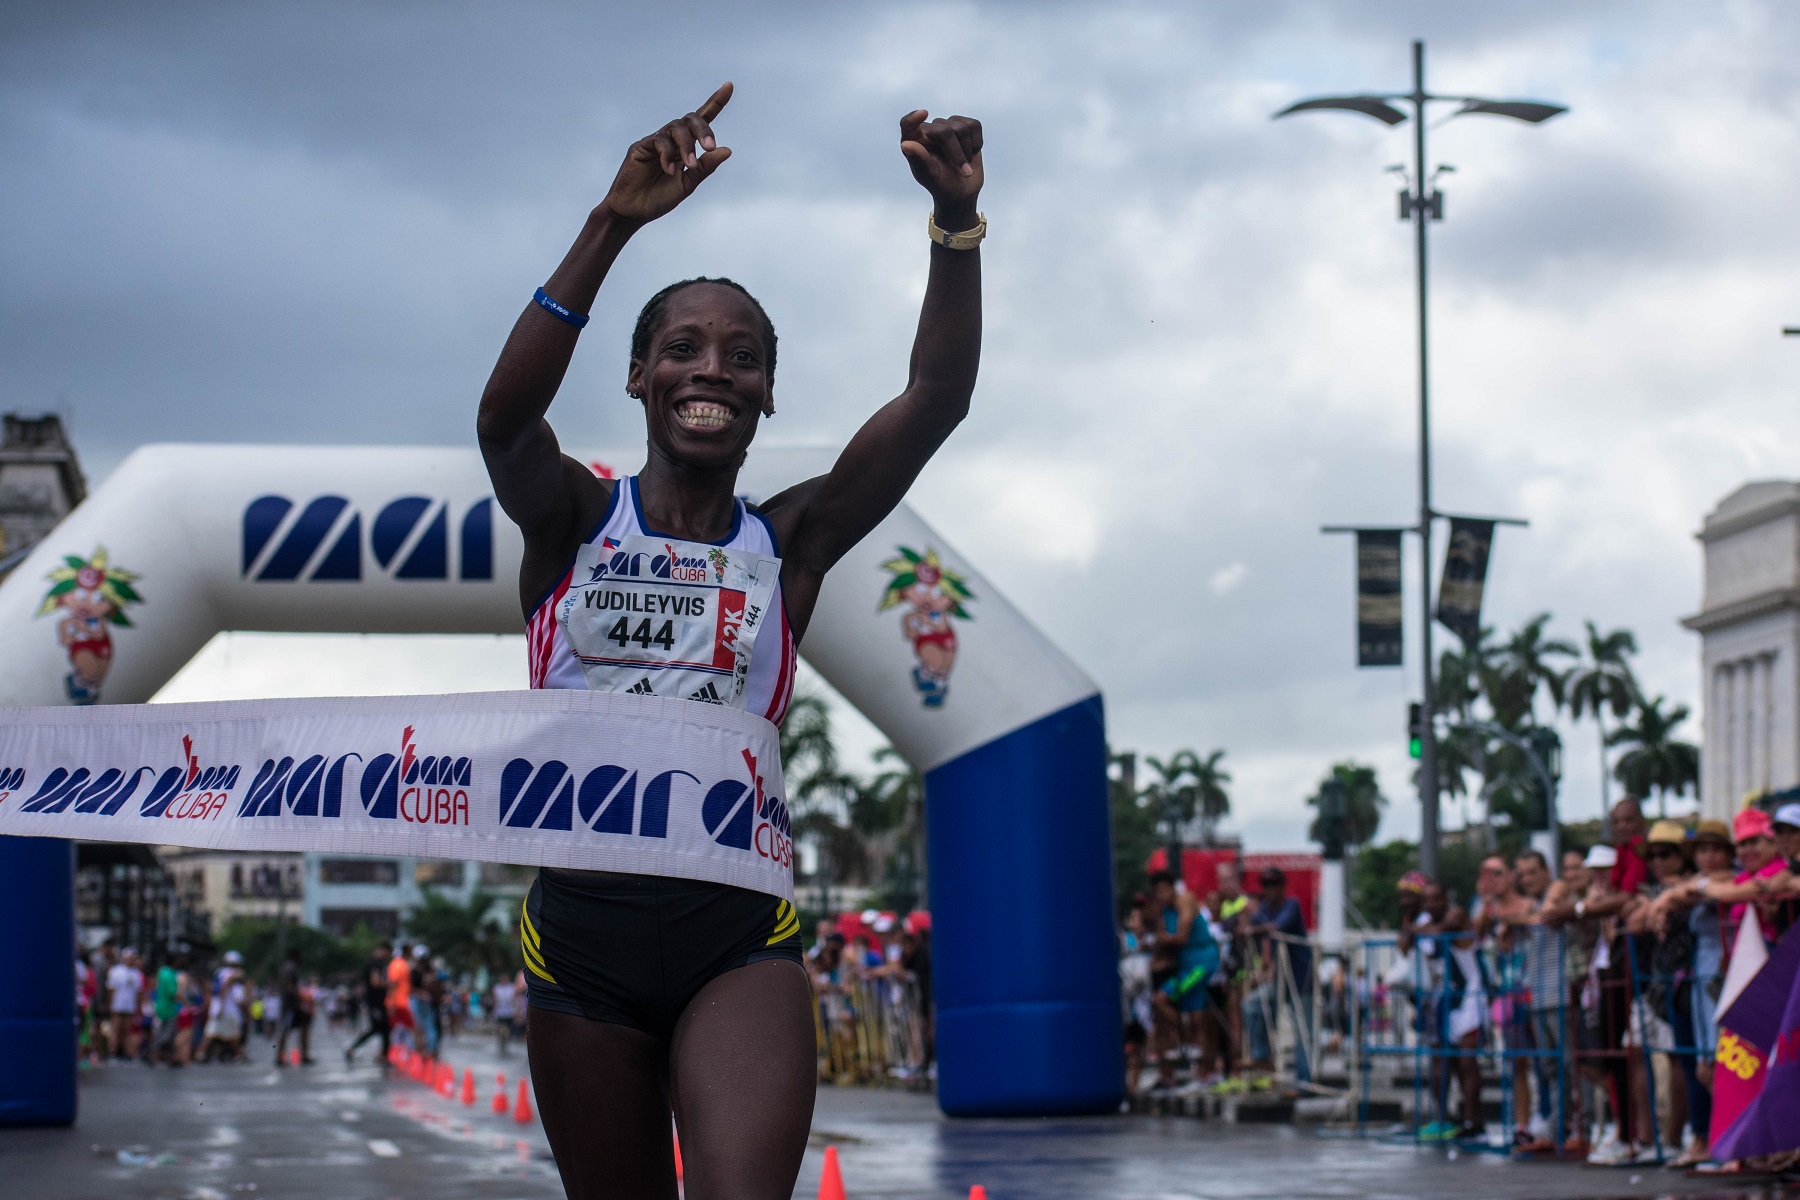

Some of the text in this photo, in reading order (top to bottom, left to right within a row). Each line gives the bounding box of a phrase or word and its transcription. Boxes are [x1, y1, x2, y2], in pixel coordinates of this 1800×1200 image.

[671, 567, 707, 583] CUBA
[584, 590, 706, 616] YUDILEYVIS
[744, 604, 761, 628] 444
[607, 616, 675, 651] 444
[722, 607, 744, 653] 42K
[164, 791, 228, 821] CUBA
[400, 787, 469, 825] CUBA
